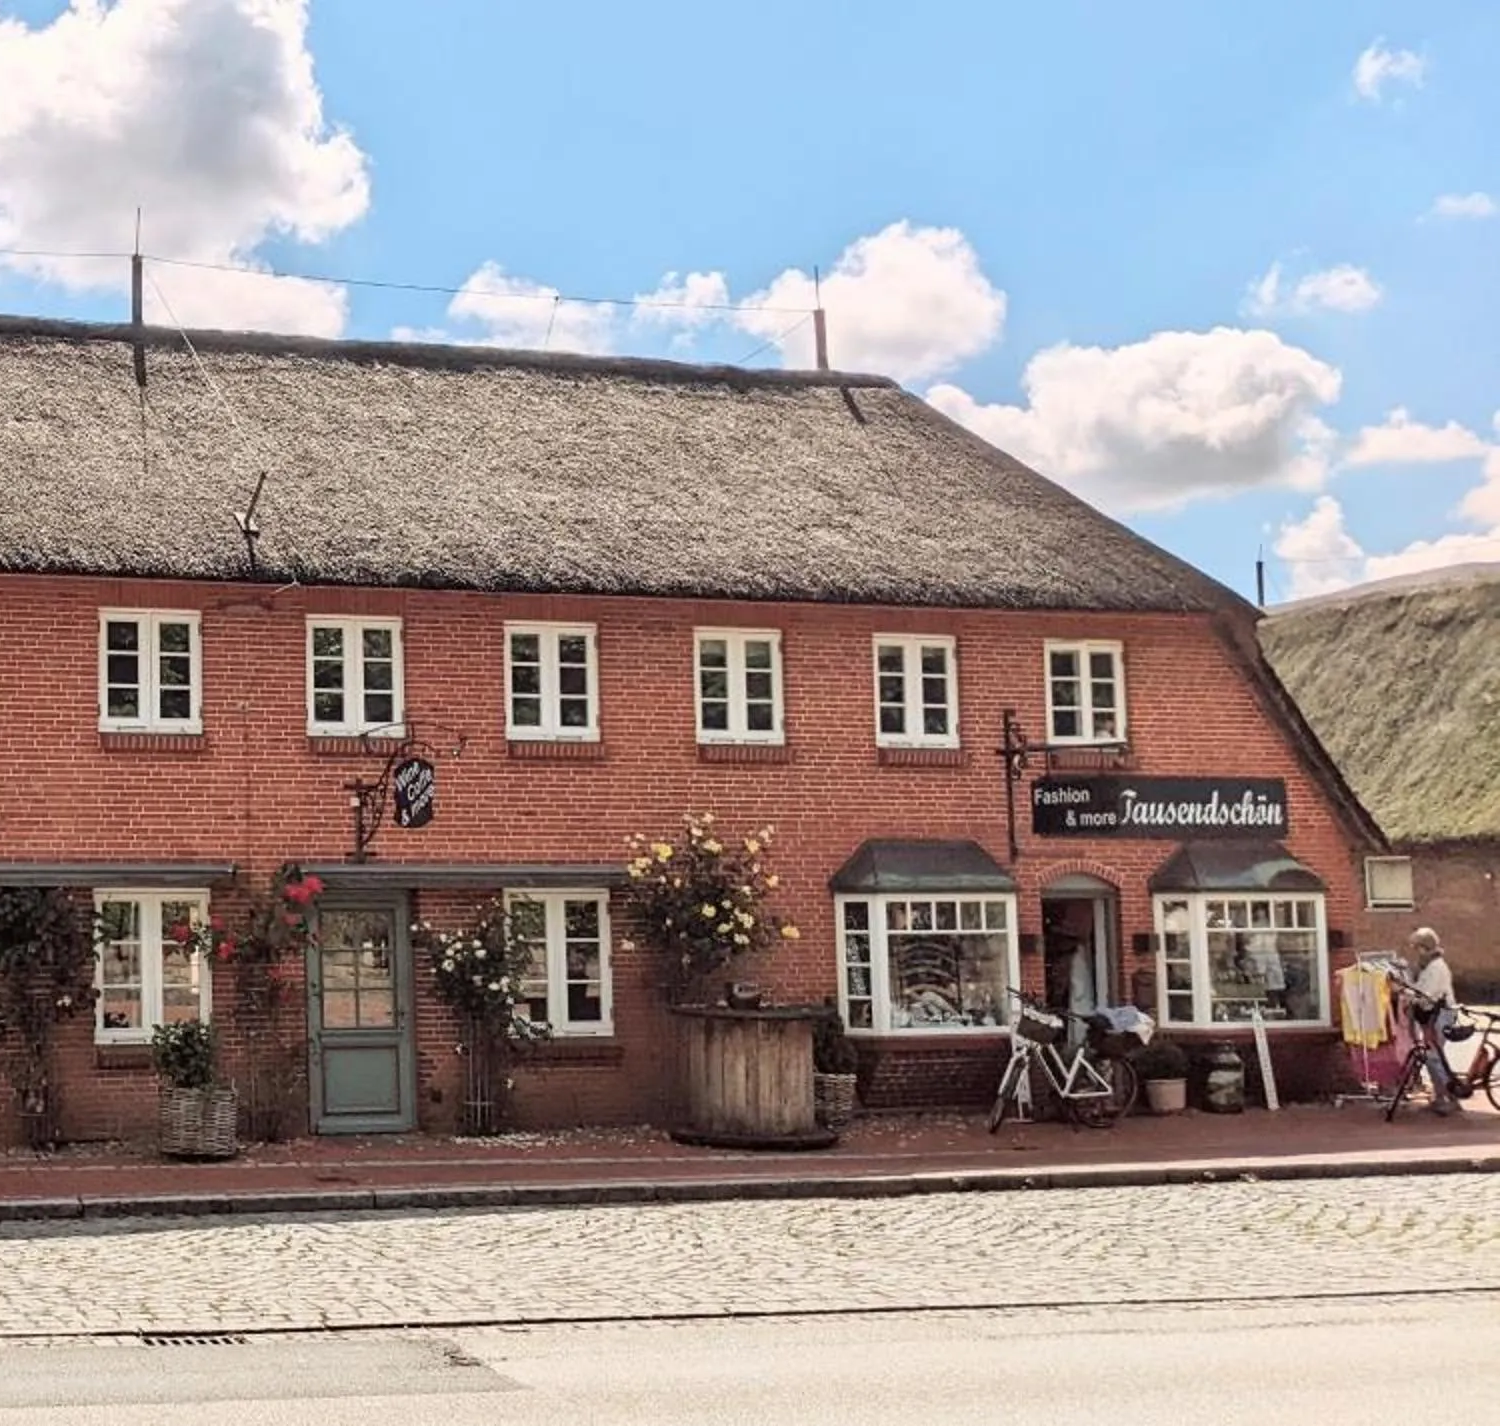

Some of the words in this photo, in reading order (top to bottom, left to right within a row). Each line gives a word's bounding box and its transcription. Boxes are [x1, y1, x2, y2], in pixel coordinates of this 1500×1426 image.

[1033, 788, 1091, 806] Fashion
[1119, 788, 1283, 826] Tausendschön
[1065, 810, 1077, 827] &
[1079, 811, 1118, 826] more
